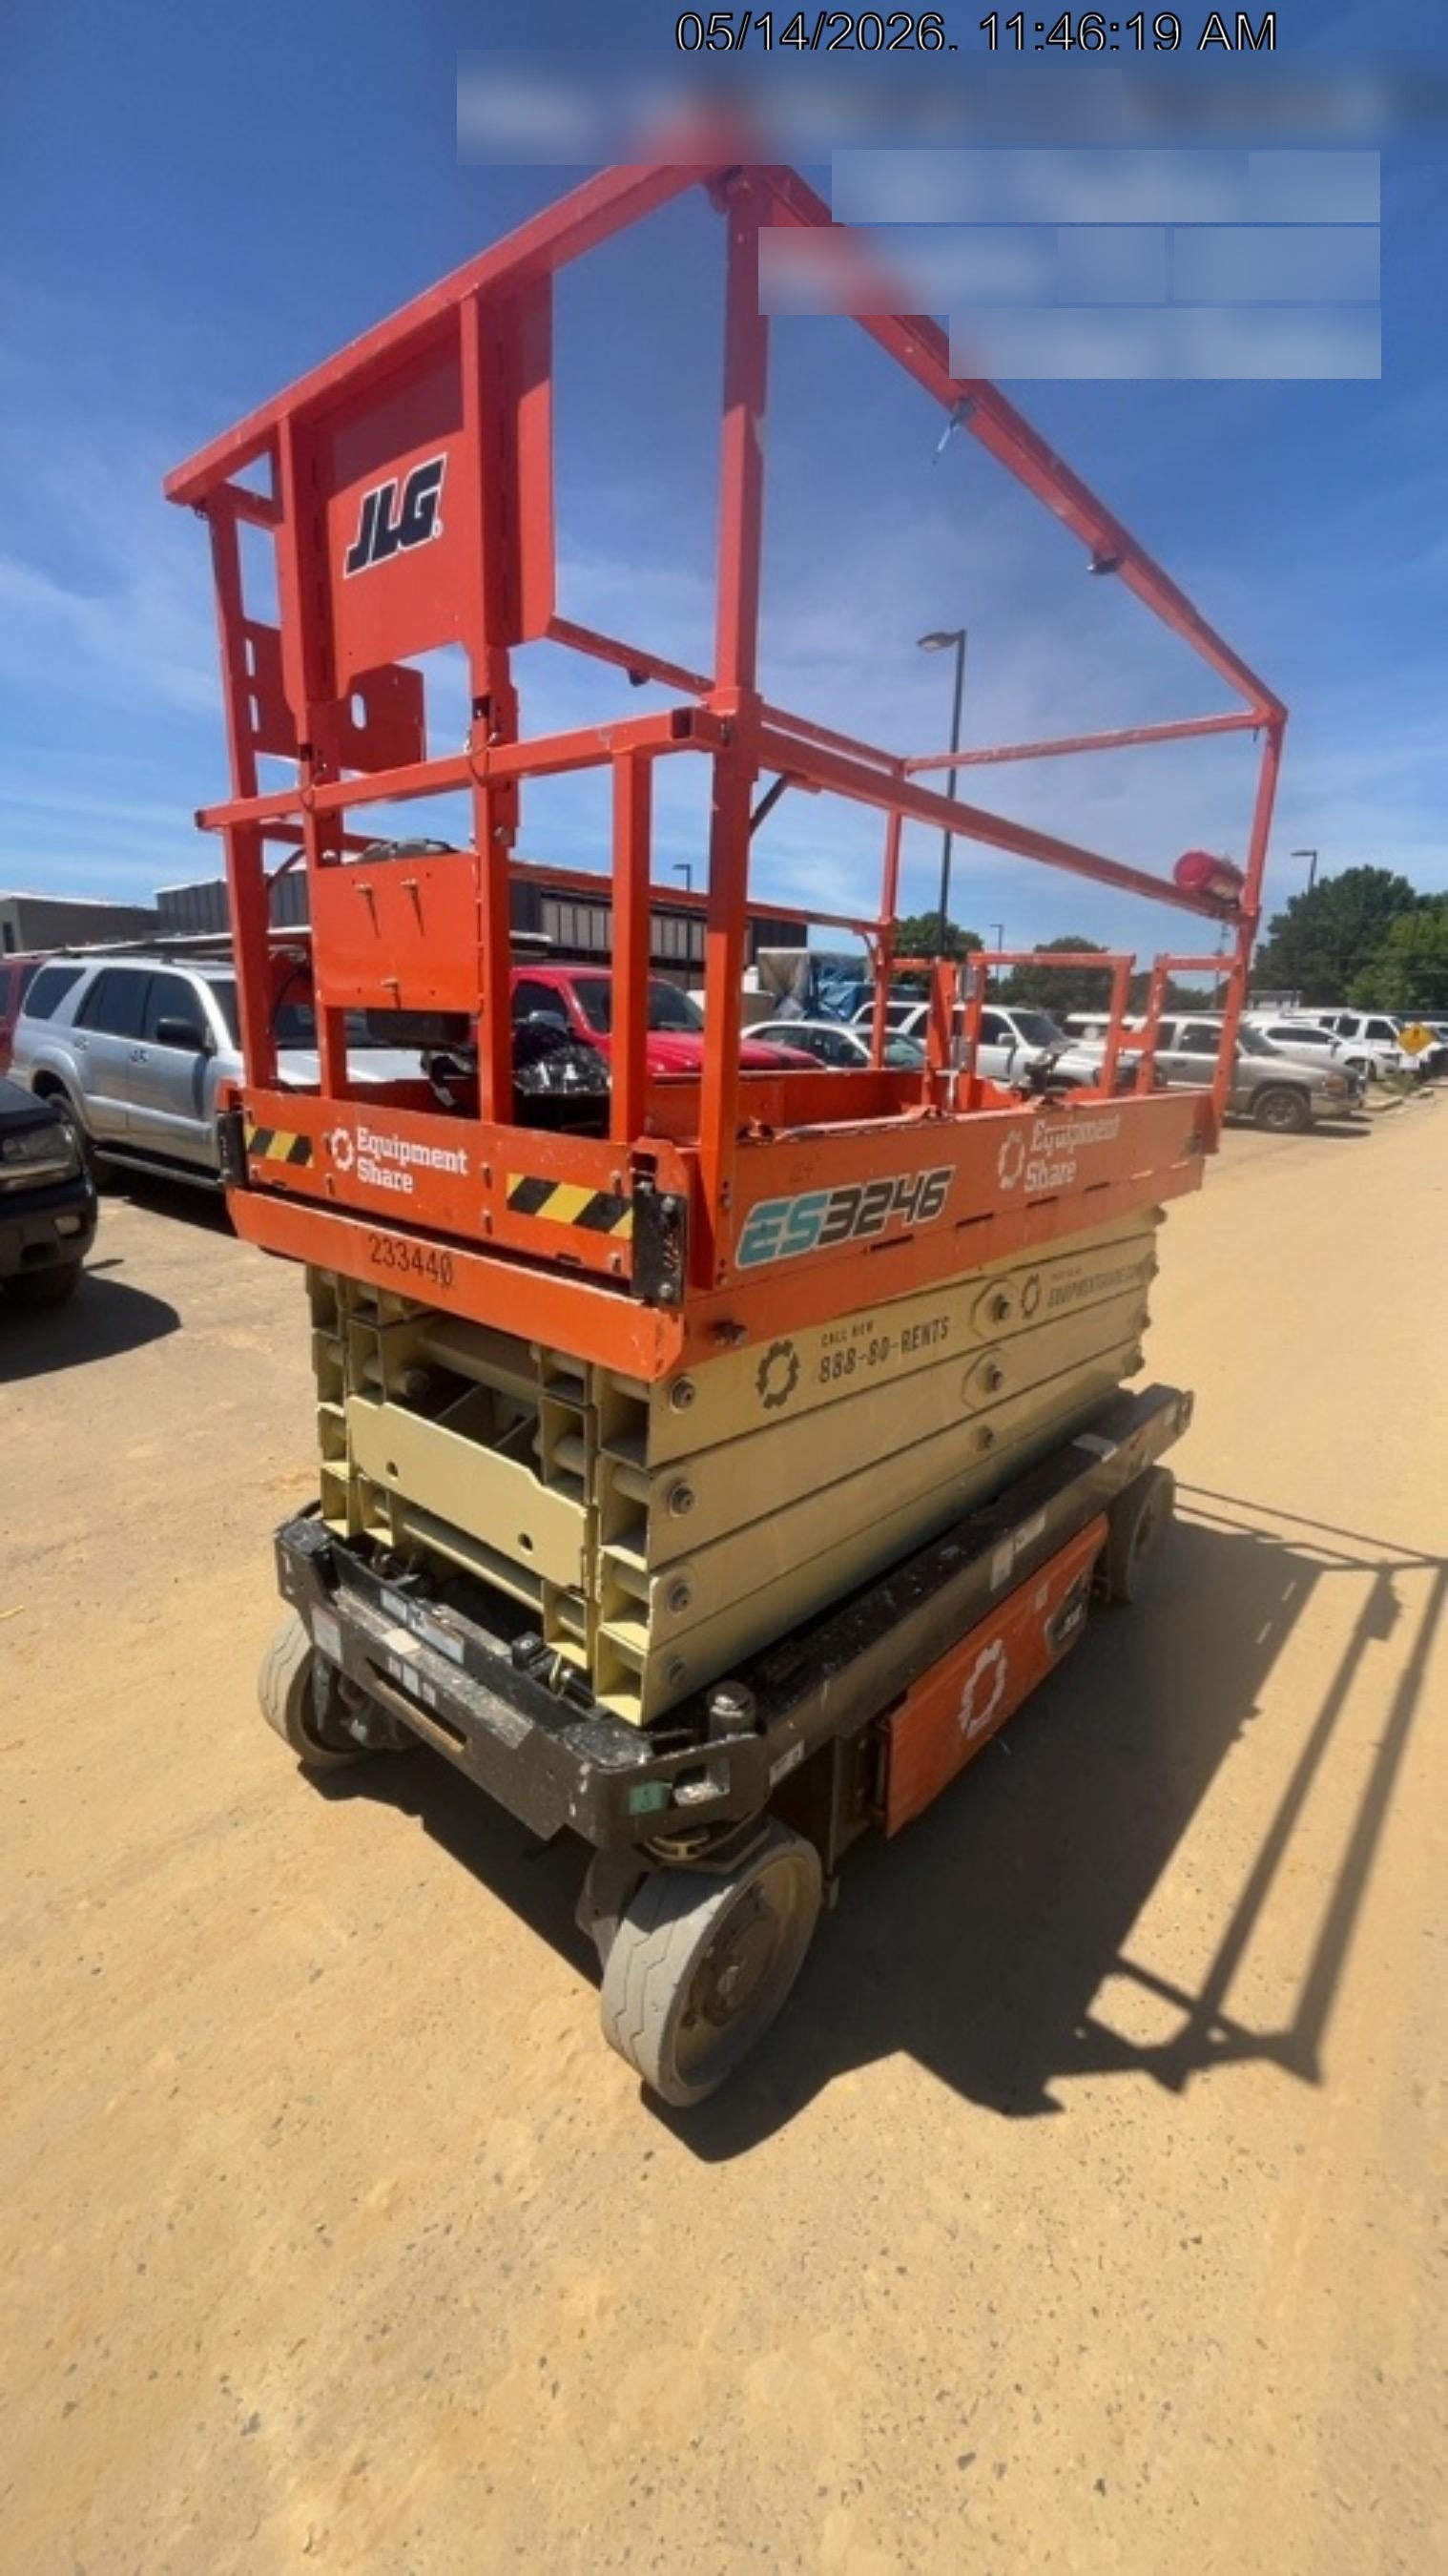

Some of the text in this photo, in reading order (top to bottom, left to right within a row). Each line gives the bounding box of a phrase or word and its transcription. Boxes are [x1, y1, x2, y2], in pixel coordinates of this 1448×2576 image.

[342, 450, 447, 580] JLG
[356, 1125, 468, 1176] Equipment
[1029, 1112, 1121, 1156] Equipment
[357, 1155, 414, 1194] Share
[1024, 1159, 1077, 1192] Share
[734, 1164, 957, 1271] ES3246
[368, 1232, 454, 1288] 233440
